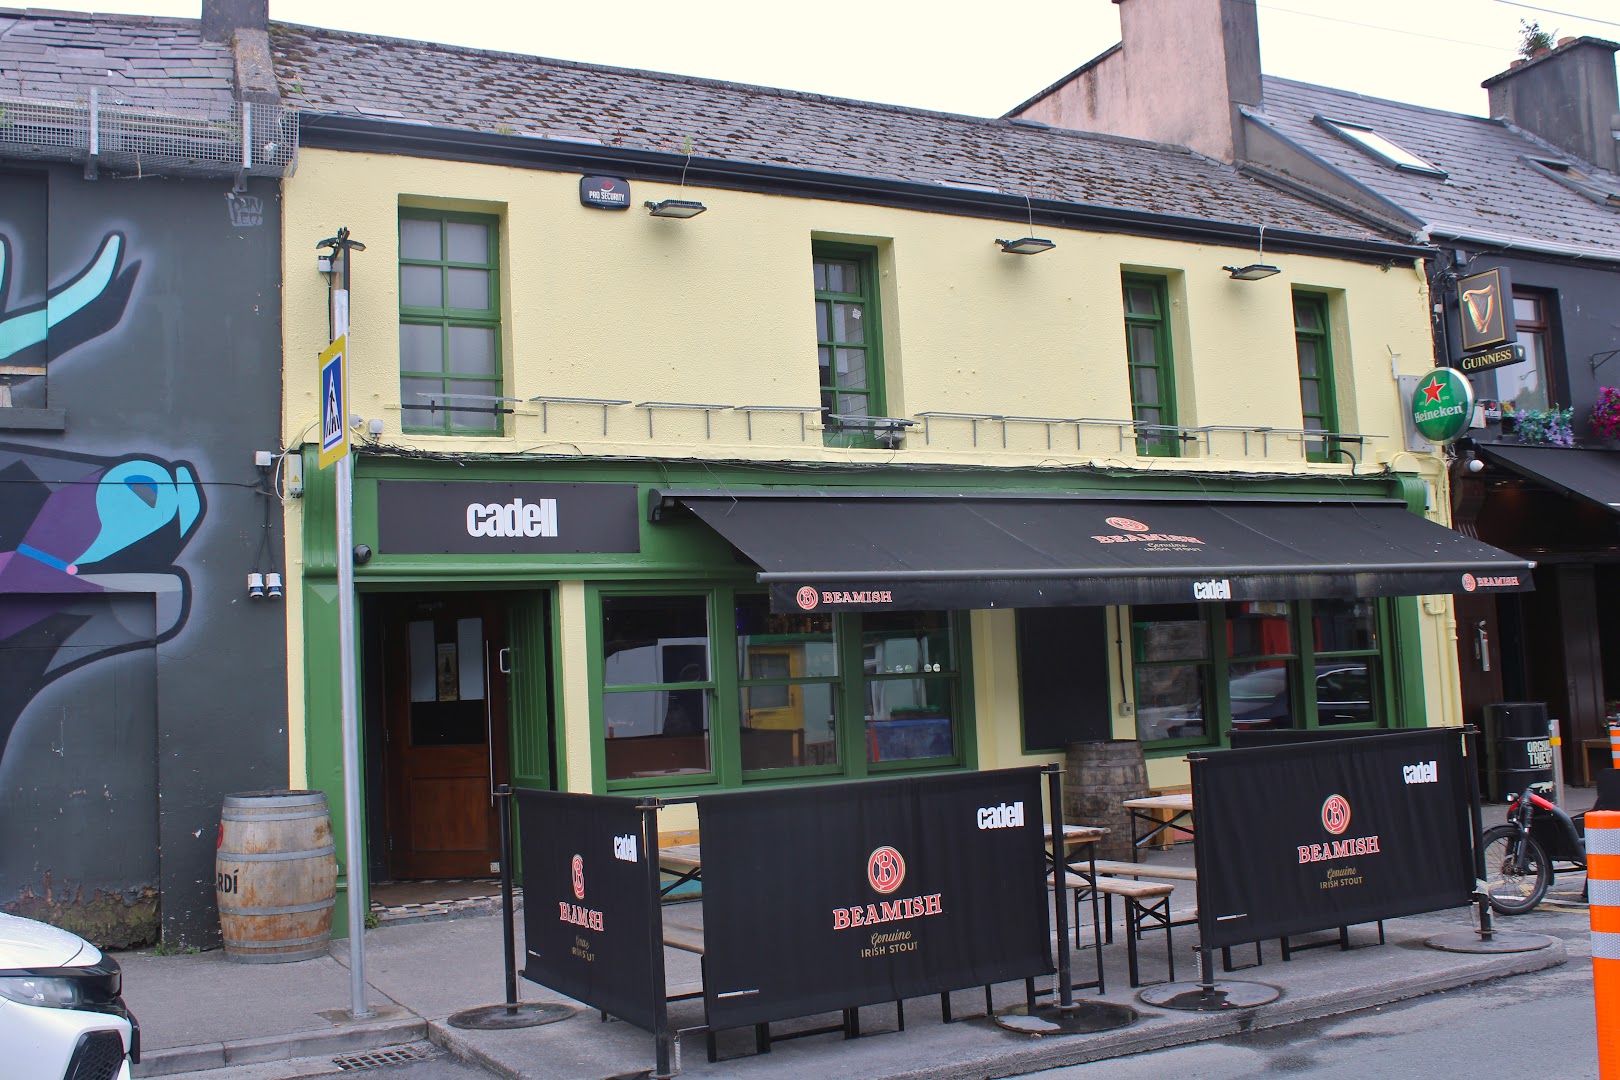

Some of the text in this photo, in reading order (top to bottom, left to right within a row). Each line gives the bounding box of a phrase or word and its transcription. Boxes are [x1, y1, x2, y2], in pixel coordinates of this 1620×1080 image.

[589, 190, 625, 201] PRO SECURITY
[1462, 349, 1512, 370] GUINNESS
[1414, 404, 1464, 424] Heineken
[466, 498, 558, 537] cadell
[1193, 579, 1232, 600] cadell
[1476, 576, 1520, 587] BEAMISH
[822, 590, 892, 604] BEAMISH
[1403, 760, 1438, 784] cadell
[977, 801, 1025, 830] cadell
[613, 834, 638, 863] cadell
[1297, 836, 1380, 864] BEAMISH
[1320, 876, 1363, 890] IRISH STOUT
[1327, 866, 1357, 881] Genuine
[832, 893, 943, 930] BEAMISH
[871, 929, 912, 947] Genuine
[861, 941, 918, 958] IRISH STOUT
